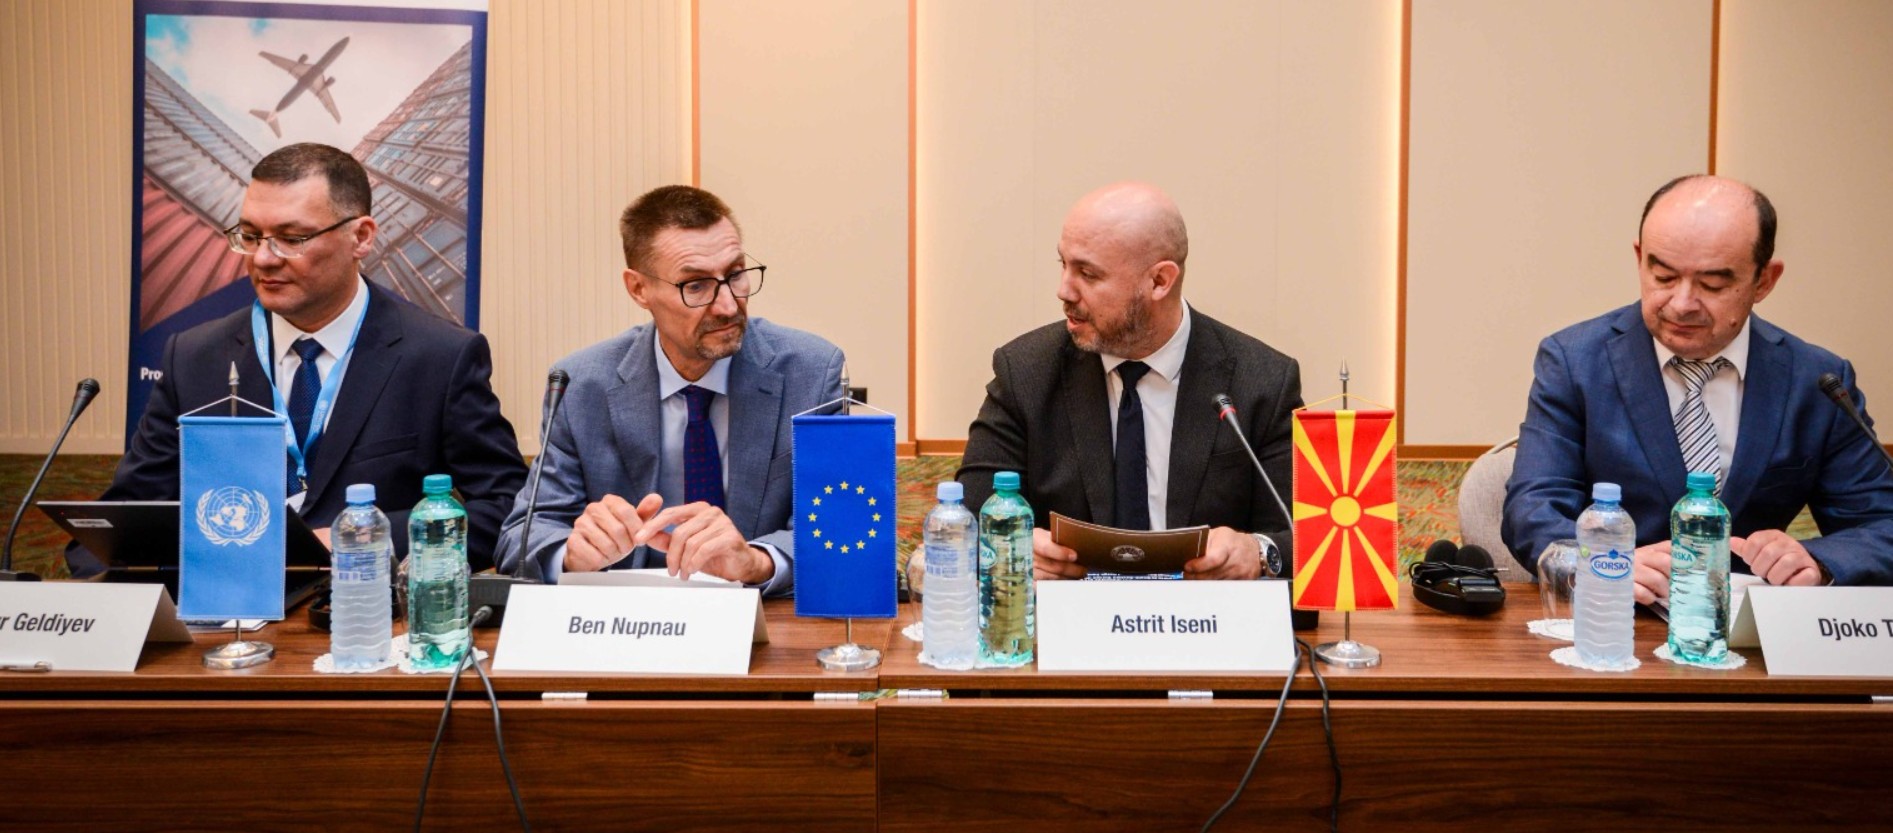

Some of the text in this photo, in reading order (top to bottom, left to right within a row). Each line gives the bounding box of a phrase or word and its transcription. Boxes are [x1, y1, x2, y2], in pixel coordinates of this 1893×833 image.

[141, 367, 164, 380] Pro
[1594, 561, 1629, 570] GORSKA
[1673, 551, 1693, 562] RSKA
[13, 612, 96, 636] Geldiyev
[568, 616, 686, 639] Ben Nupnau
[1111, 614, 1217, 633] Astrit Iseni
[1817, 618, 1878, 640] Djoko
